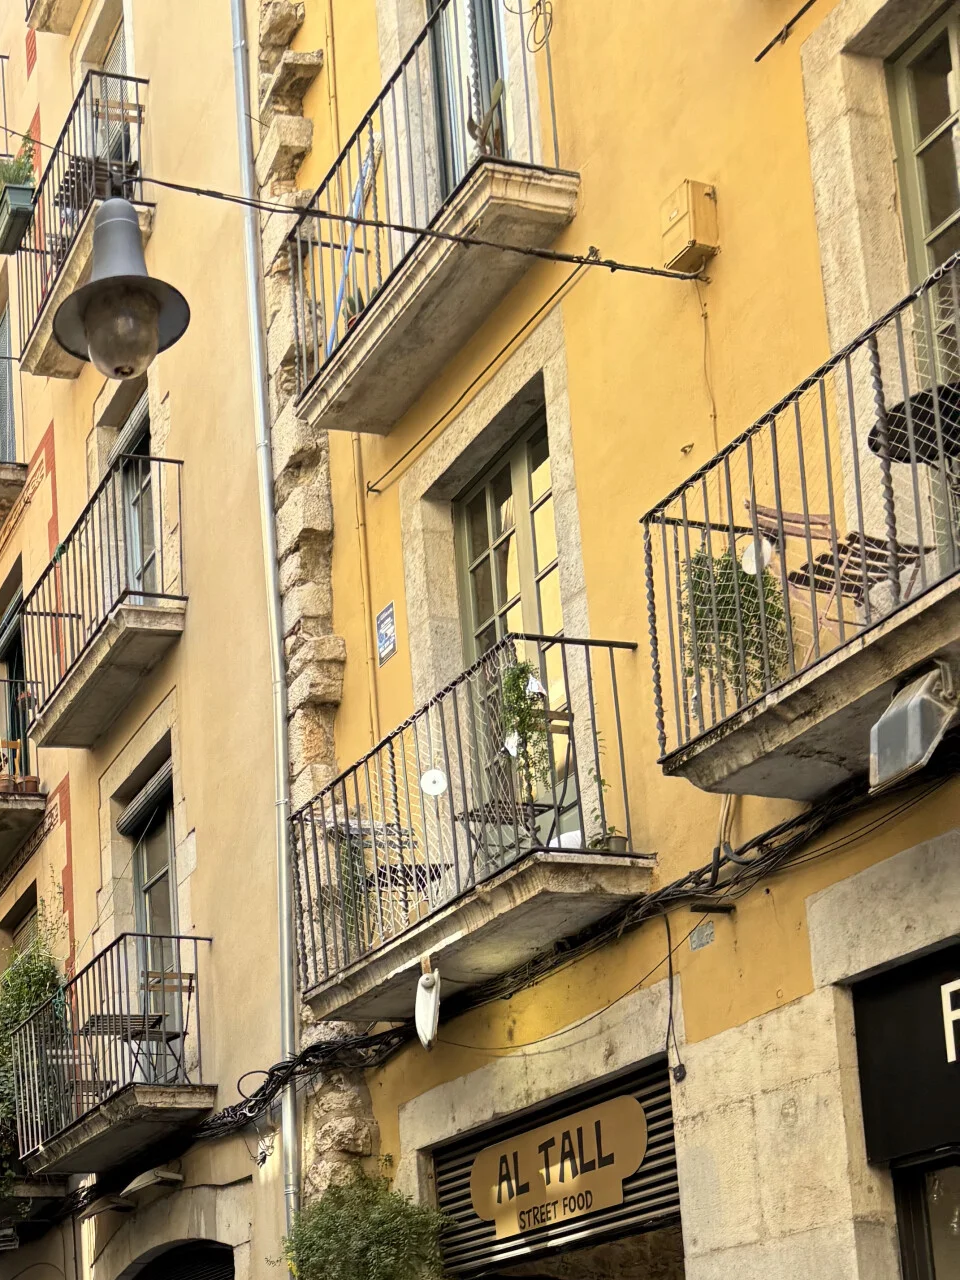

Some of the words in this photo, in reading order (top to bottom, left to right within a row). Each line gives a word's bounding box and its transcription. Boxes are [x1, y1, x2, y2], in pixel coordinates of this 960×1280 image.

[496, 1151, 530, 1204] AL
[538, 1119, 615, 1186] TALL
[519, 1200, 559, 1231] STREET
[563, 1190, 593, 1216] FOOD
